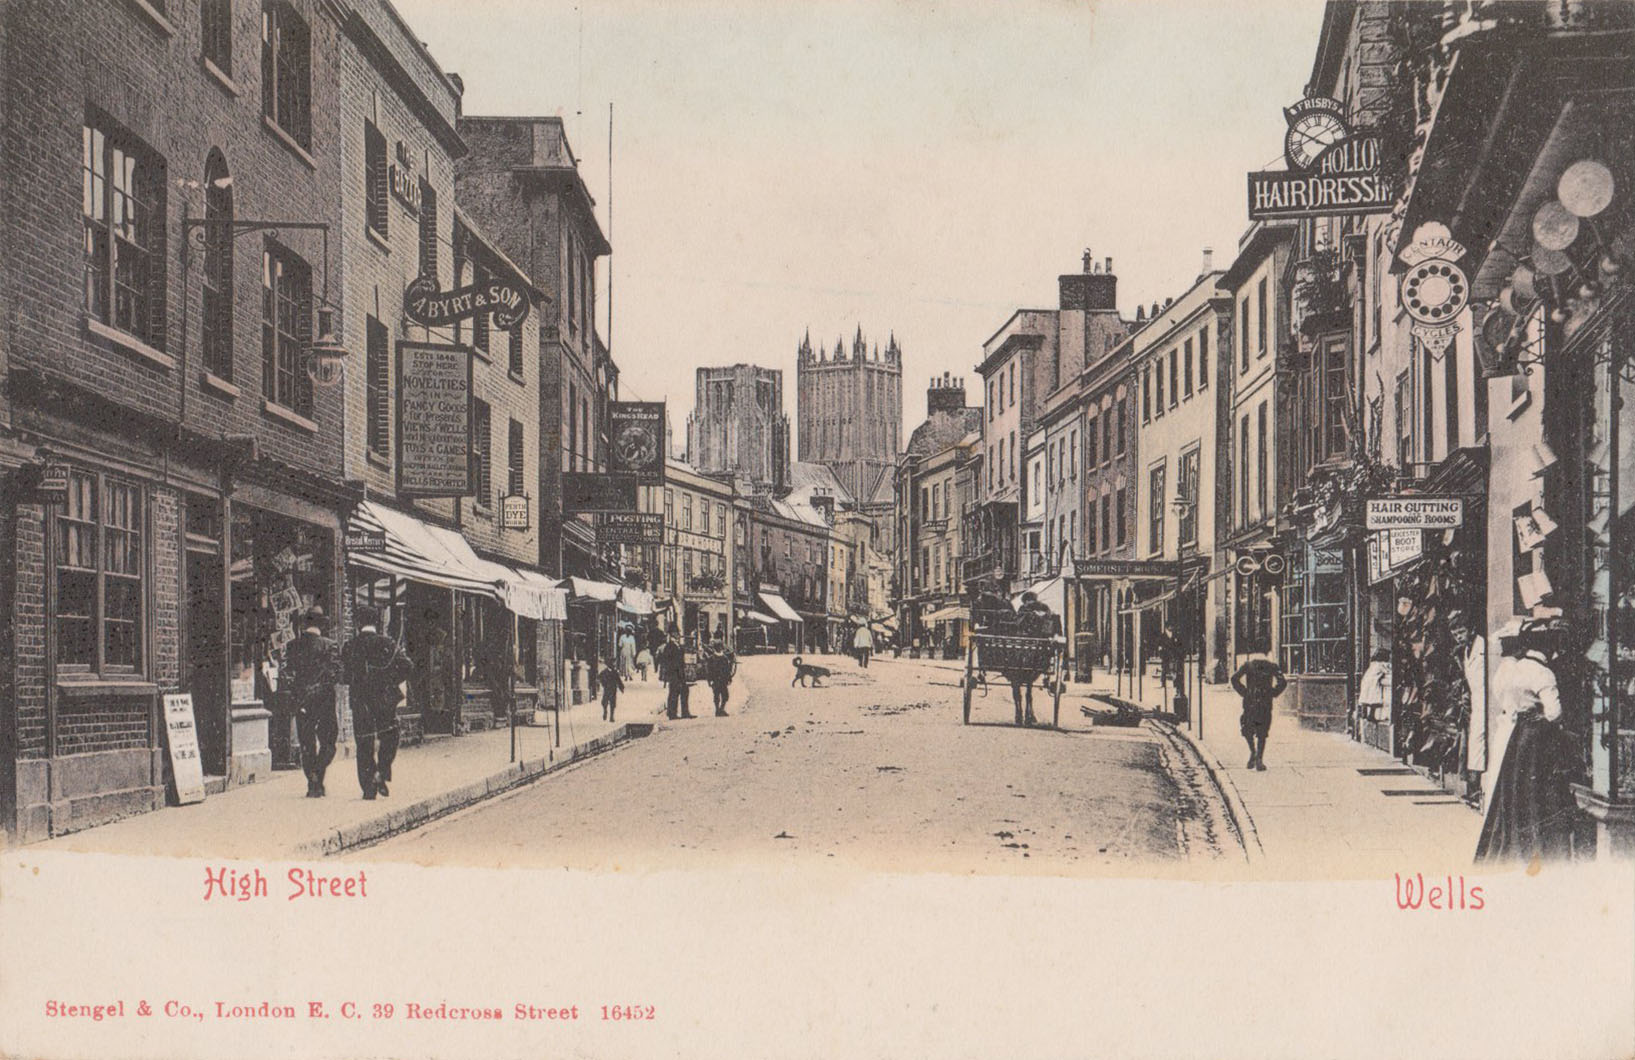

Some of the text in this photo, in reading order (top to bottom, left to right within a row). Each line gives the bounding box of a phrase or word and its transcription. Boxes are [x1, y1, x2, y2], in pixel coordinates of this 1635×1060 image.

[428, 294, 472, 318] BYRT
[475, 294, 487, 306] &
[489, 286, 521, 309] SON
[1414, 323, 1460, 337] CYCLES
[412, 360, 459, 370] STOP HERE
[403, 375, 467, 391] NOVELTIES
[403, 399, 468, 413] FANCY GOODS
[436, 444, 466, 455] GAMES
[1371, 502, 1402, 513] HAIR
[506, 511, 526, 519] DYE
[610, 514, 661, 523] POSTING
[1424, 514, 1456, 524] ROOMS
[1395, 538, 1416, 546] BOOT
